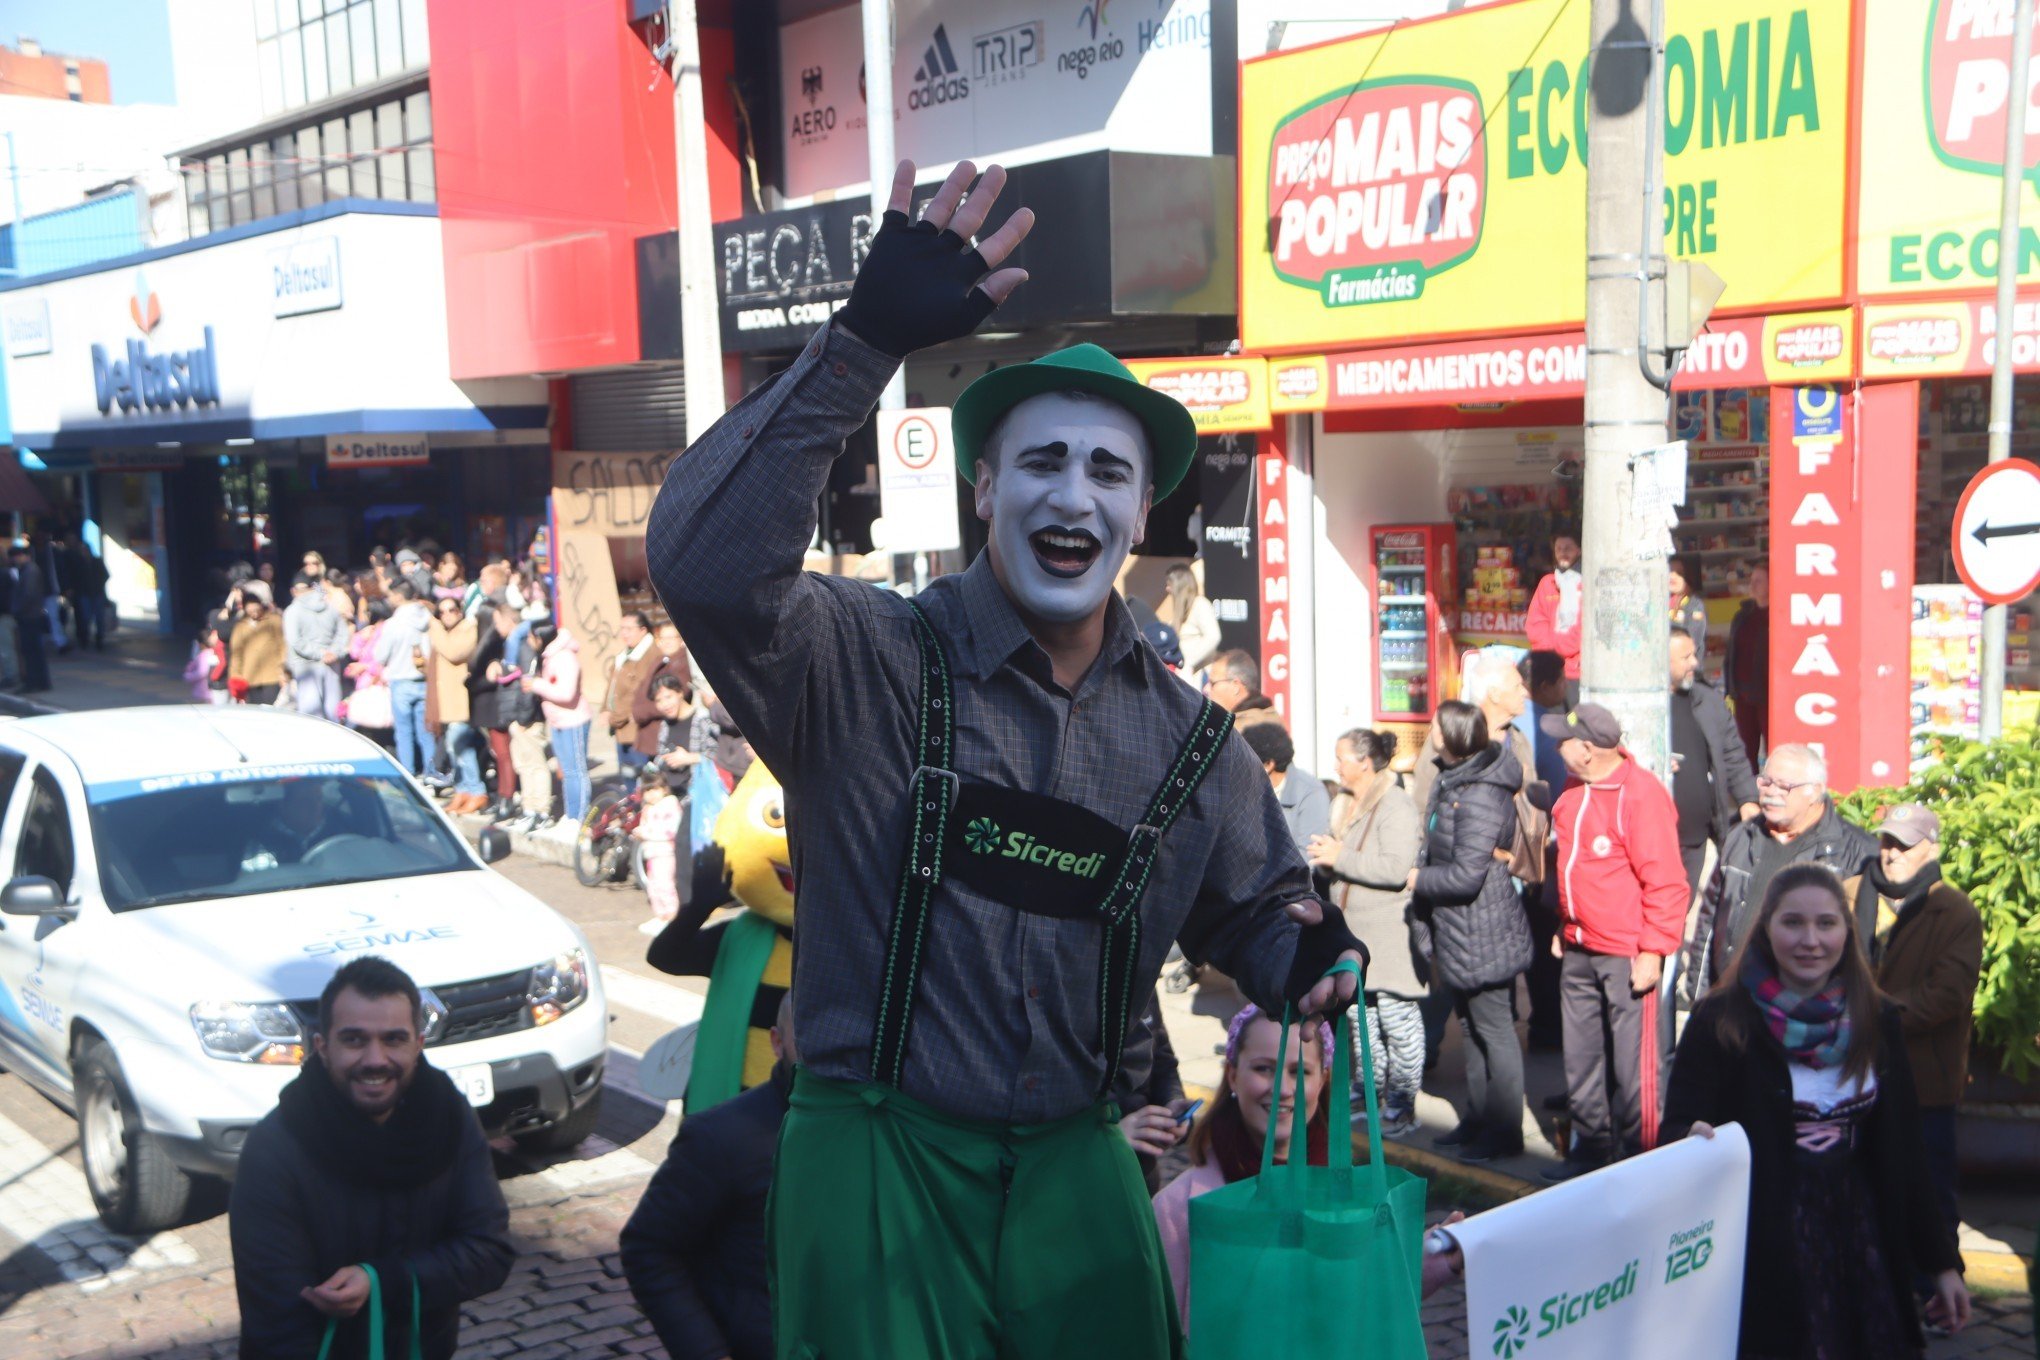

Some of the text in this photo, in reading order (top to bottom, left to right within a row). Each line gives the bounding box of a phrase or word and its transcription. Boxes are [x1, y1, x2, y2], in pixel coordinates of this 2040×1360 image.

[1138, 9, 1211, 54] Hering
[975, 28, 1036, 74] TRIP
[1058, 46, 1096, 80] nega
[908, 76, 969, 111] adidas
[1507, 9, 1820, 180] ECOMIA
[792, 106, 836, 138] AERO
[1275, 96, 1474, 192] PREÇO MAIS
[1277, 172, 1479, 263] POPULAR
[273, 254, 334, 299] Deltasul
[724, 220, 832, 297] PEÇA
[1328, 267, 1418, 305] Farmácias
[737, 306, 787, 331] MODA
[788, 300, 831, 326] COM
[1795, 326, 1841, 343] MAIS
[91, 325, 221, 415] Deltasul
[1777, 341, 1843, 361] POPULAR
[1179, 370, 1247, 388] MAIS
[1336, 344, 1587, 397] MEDICAMENTOS COM
[352, 441, 427, 458] Deltasul
[907, 428, 924, 458] E
[140, 763, 356, 793] DEPTO AUTOMOTIVO
[1001, 831, 1106, 879] Sicredi
[303, 926, 461, 958] SEMAE
[1668, 1219, 1714, 1250] Pioneira
[1664, 1236, 1714, 1285] 120
[1536, 1258, 1639, 1339] Sicredi
